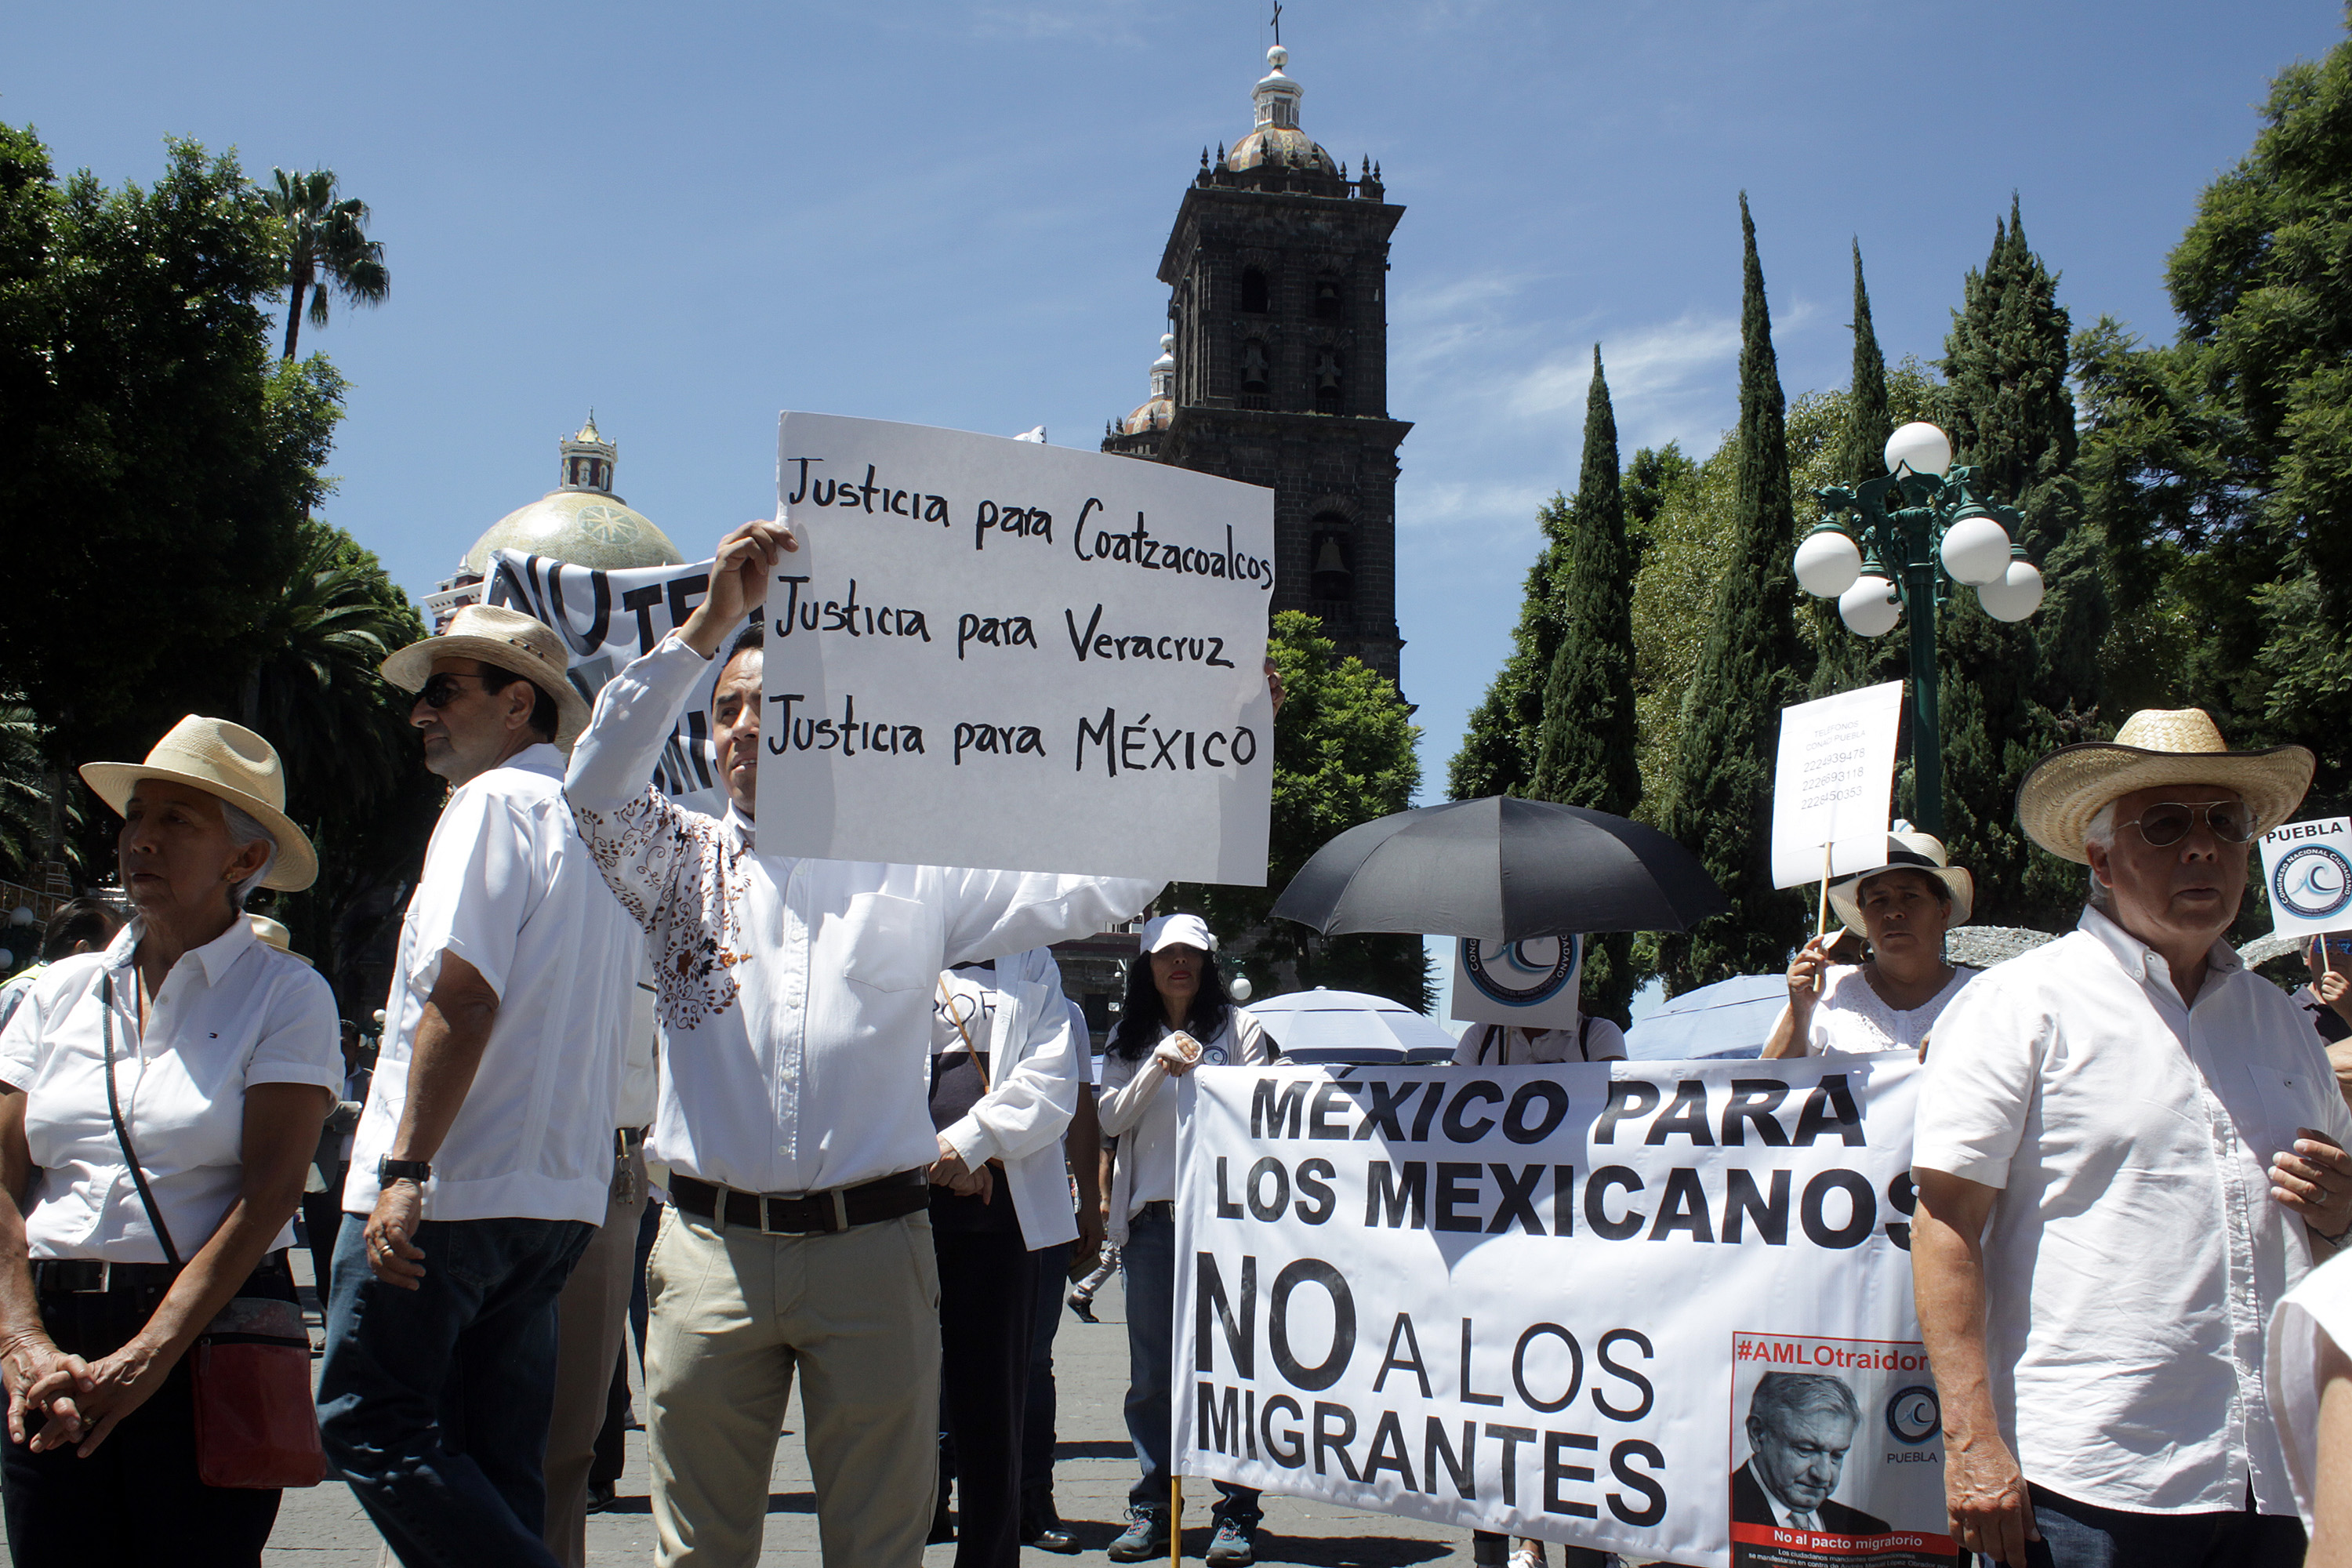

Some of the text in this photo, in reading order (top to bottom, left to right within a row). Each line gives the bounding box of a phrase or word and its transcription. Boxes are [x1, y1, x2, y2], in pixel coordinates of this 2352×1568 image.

[787, 457, 1273, 590] Justicia para Coatzacoalcos
[488, 554, 612, 657] NO
[775, 575, 1236, 669] Justicia para Veracruz
[768, 694, 925, 757] Justicia
[953, 722, 1047, 766] para
[1076, 706, 1257, 778] MÉXICO
[1803, 748, 1865, 773] 2224939478
[1834, 730, 1866, 742] PUEBLA
[2265, 822, 2344, 844] PUEBLA
[1250, 1066, 1867, 1147] MÉXICO PARA
[1216, 1156, 1337, 1225] LOS
[1195, 1250, 1654, 1423] NO A LOS
[1737, 1340, 1929, 1371] #AMLOtraidor
[1197, 1381, 1668, 1528] MIGRANTES
[1886, 1451, 1938, 1464] PUEBLA
[1773, 1530, 1923, 1551] No al pacto migratorio
[1778, 1548, 1790, 1557] Los
[1791, 1550, 1828, 1561] ciudadanos
[1807, 1559, 1828, 1568] contra
